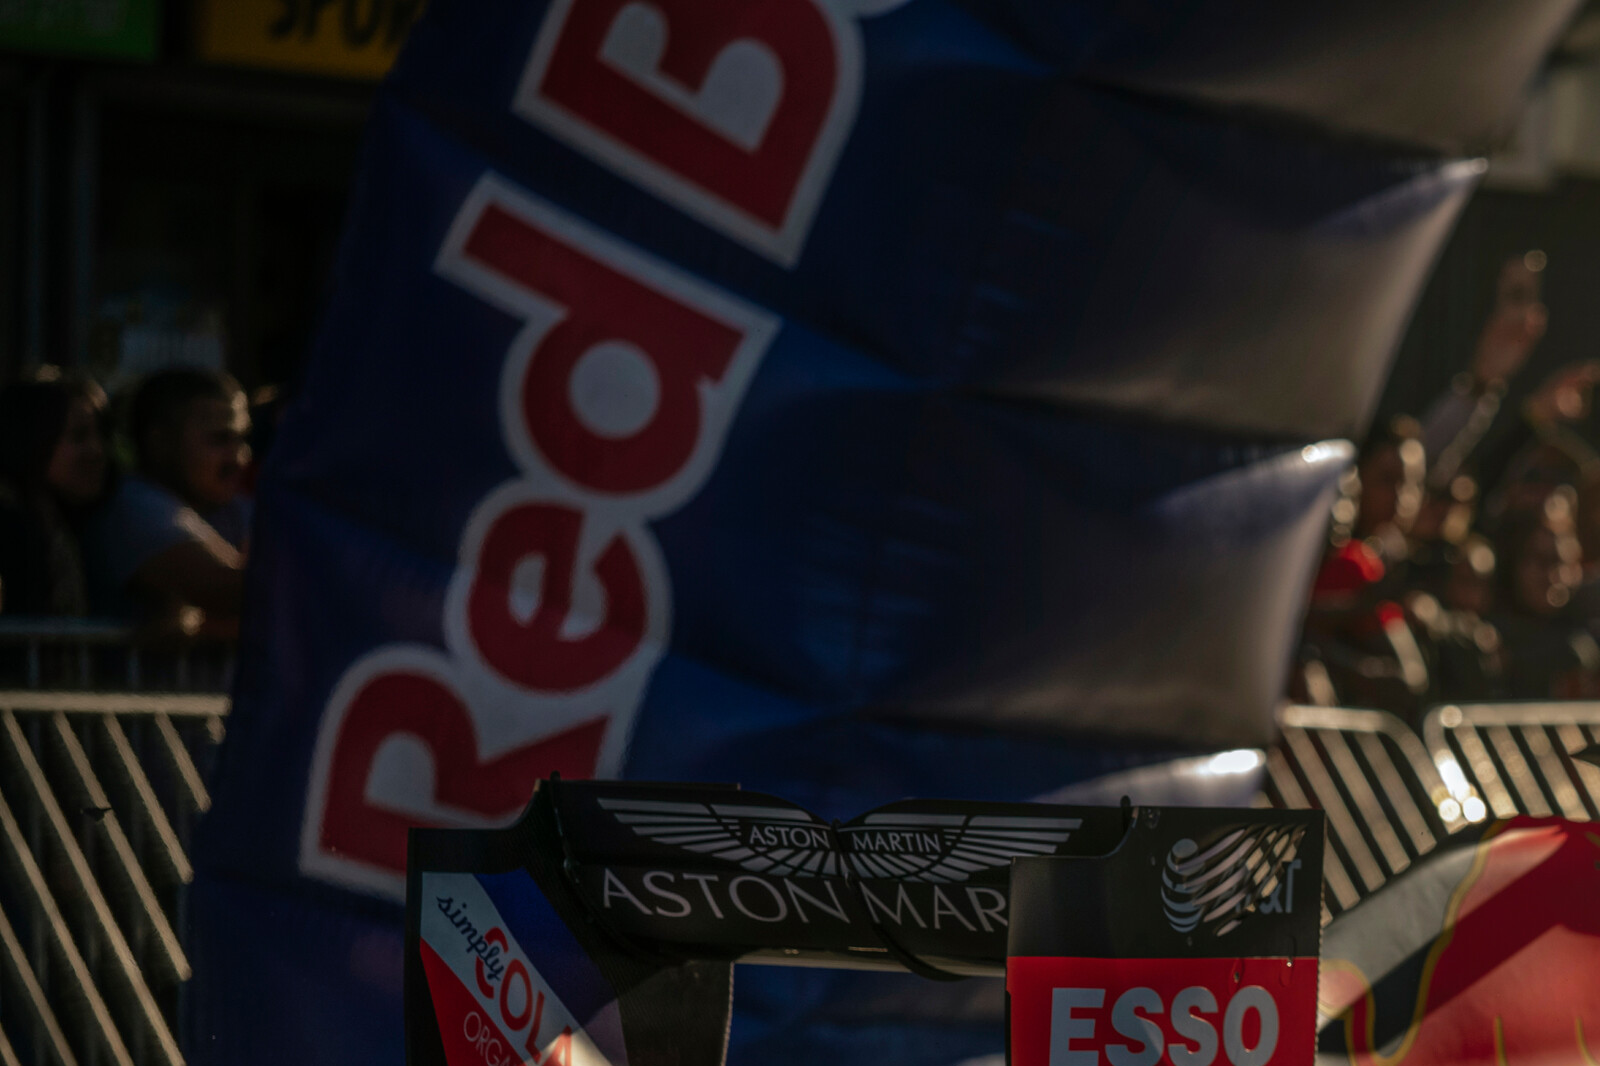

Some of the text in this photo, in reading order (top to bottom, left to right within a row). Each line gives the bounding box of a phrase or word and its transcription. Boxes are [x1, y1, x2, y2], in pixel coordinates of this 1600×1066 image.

[748, 825, 941, 854] ASTON MARTIN
[602, 867, 852, 925] ASTON
[436, 896, 505, 981] simply
